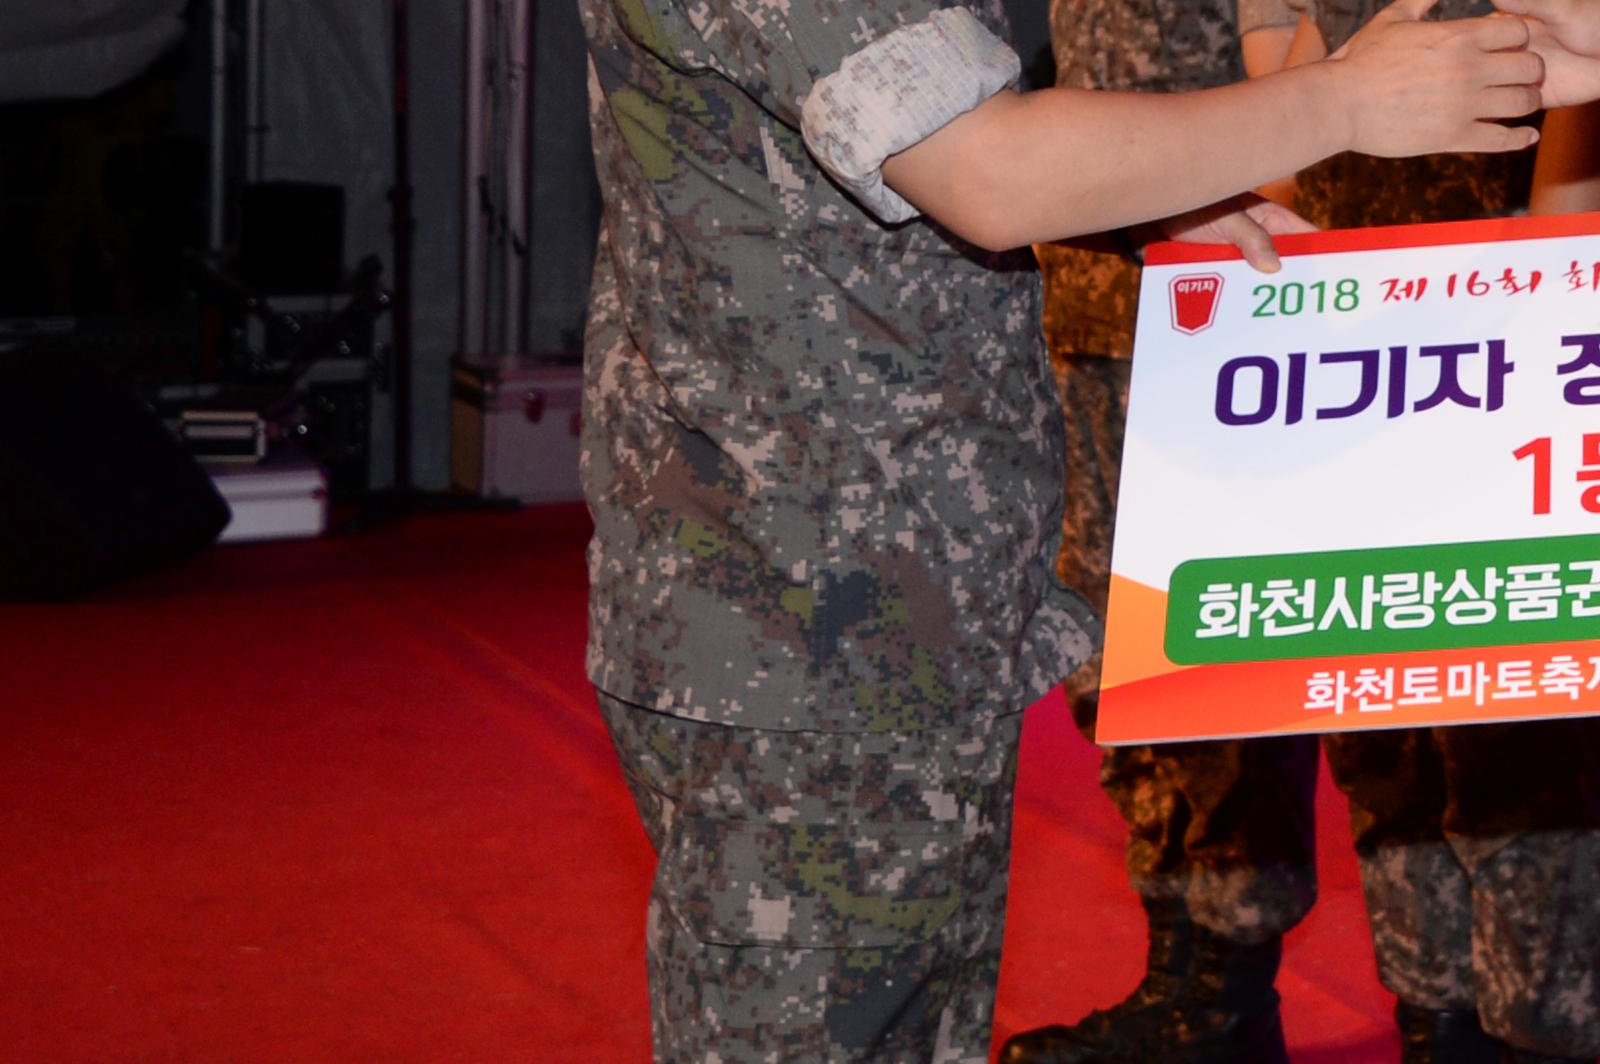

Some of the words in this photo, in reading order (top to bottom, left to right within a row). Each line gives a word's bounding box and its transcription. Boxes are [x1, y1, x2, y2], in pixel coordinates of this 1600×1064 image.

[1176, 278, 1218, 296] 이기자
[1251, 278, 1361, 319] 2018
[1214, 338, 1515, 427] 이기자
